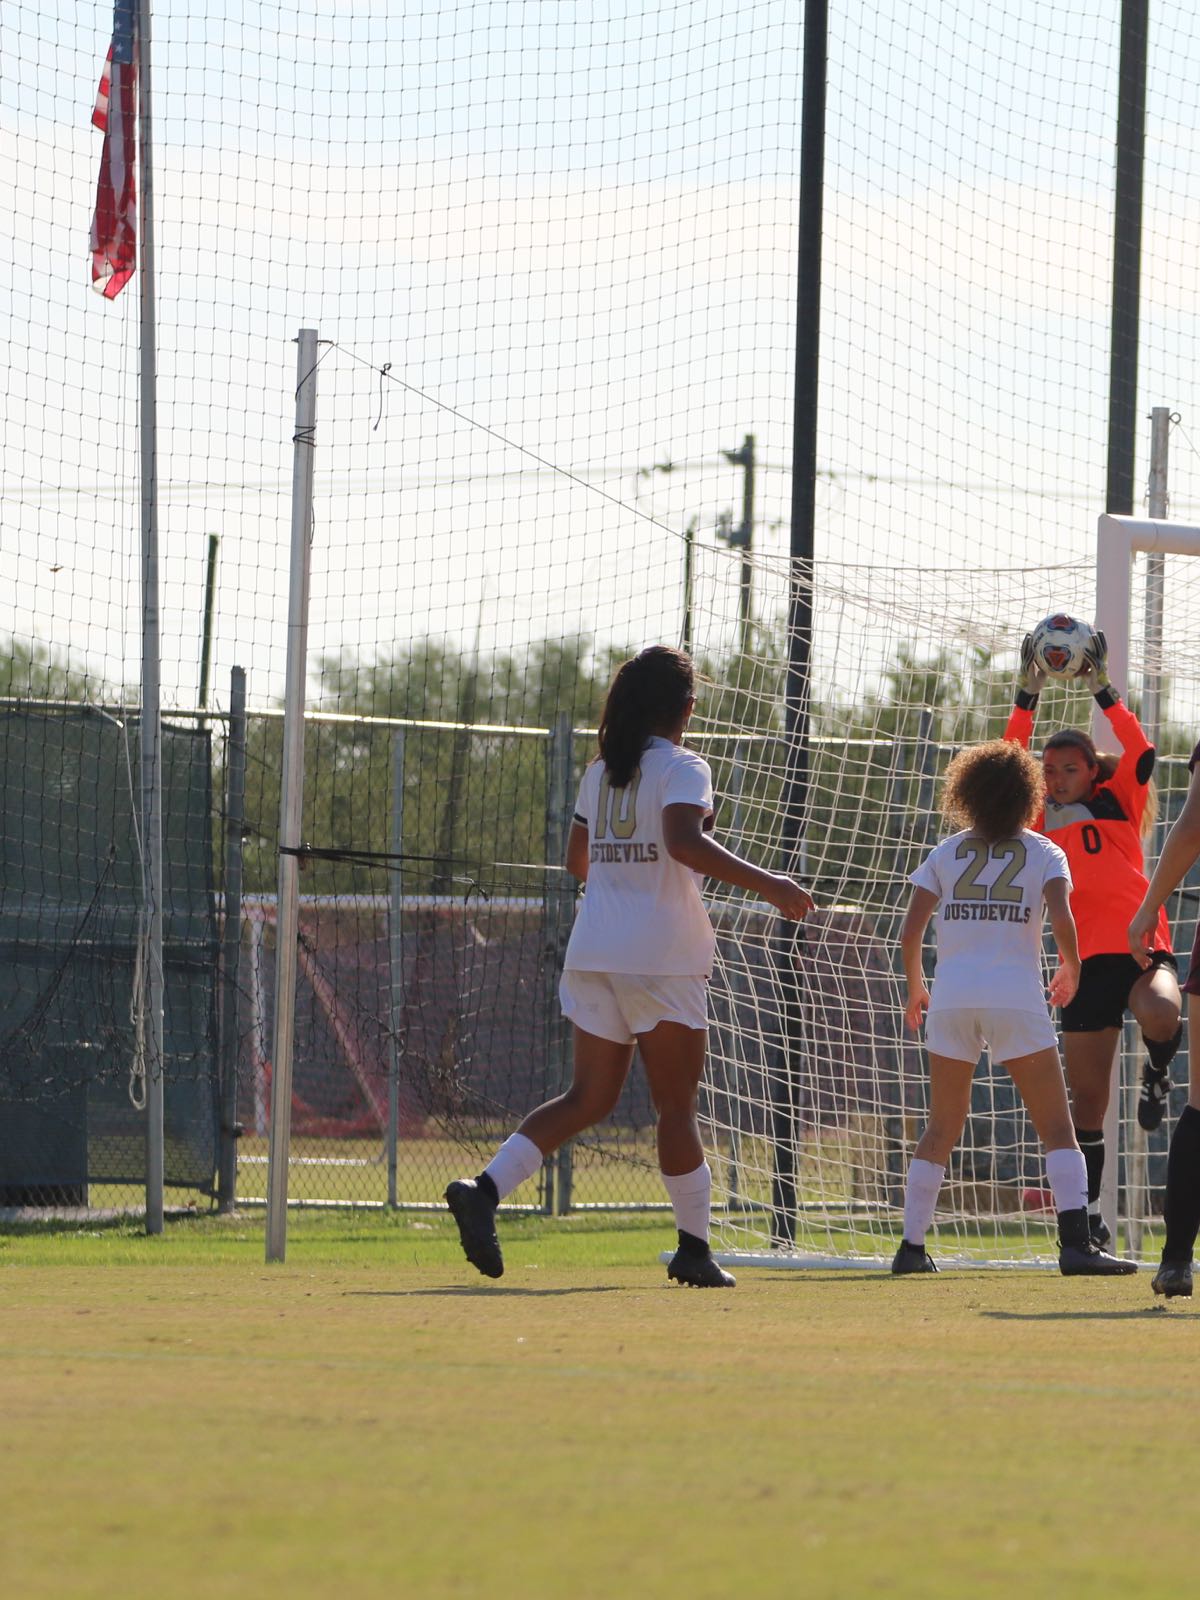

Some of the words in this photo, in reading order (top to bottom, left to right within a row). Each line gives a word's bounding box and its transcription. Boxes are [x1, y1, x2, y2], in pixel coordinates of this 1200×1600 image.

[594, 766, 643, 840] 10
[1081, 824, 1102, 855] 0
[952, 837, 1027, 904] 22
[943, 903, 1032, 924] DUSTDEVILS
